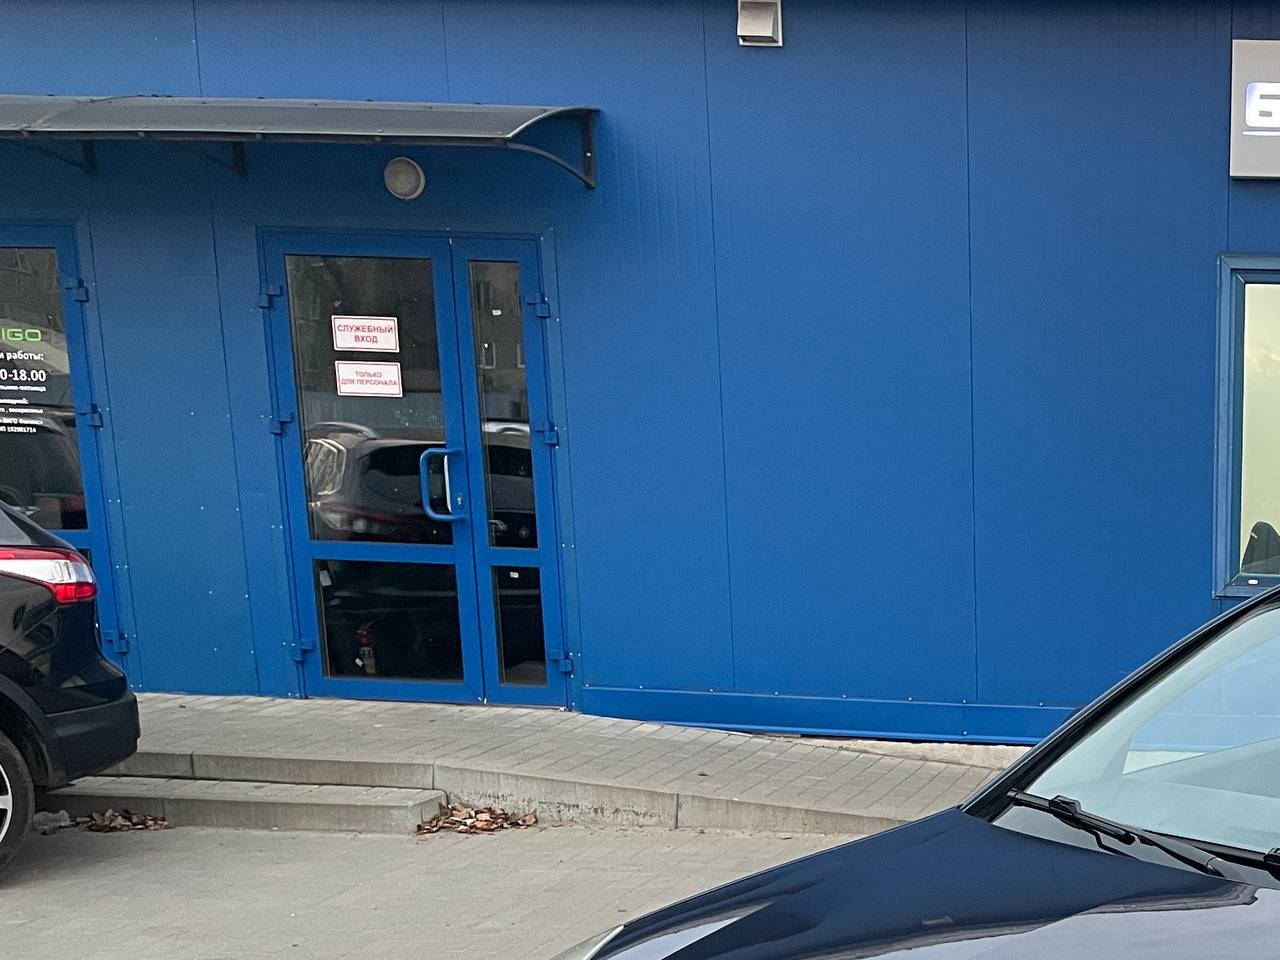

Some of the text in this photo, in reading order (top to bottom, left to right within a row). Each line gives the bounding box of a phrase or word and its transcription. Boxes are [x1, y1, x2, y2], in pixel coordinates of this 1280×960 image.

[337, 323, 394, 334] СЛУЖЕБНЫЙ
[354, 335, 379, 344] ВХОД
[6, 350, 44, 361] работы:
